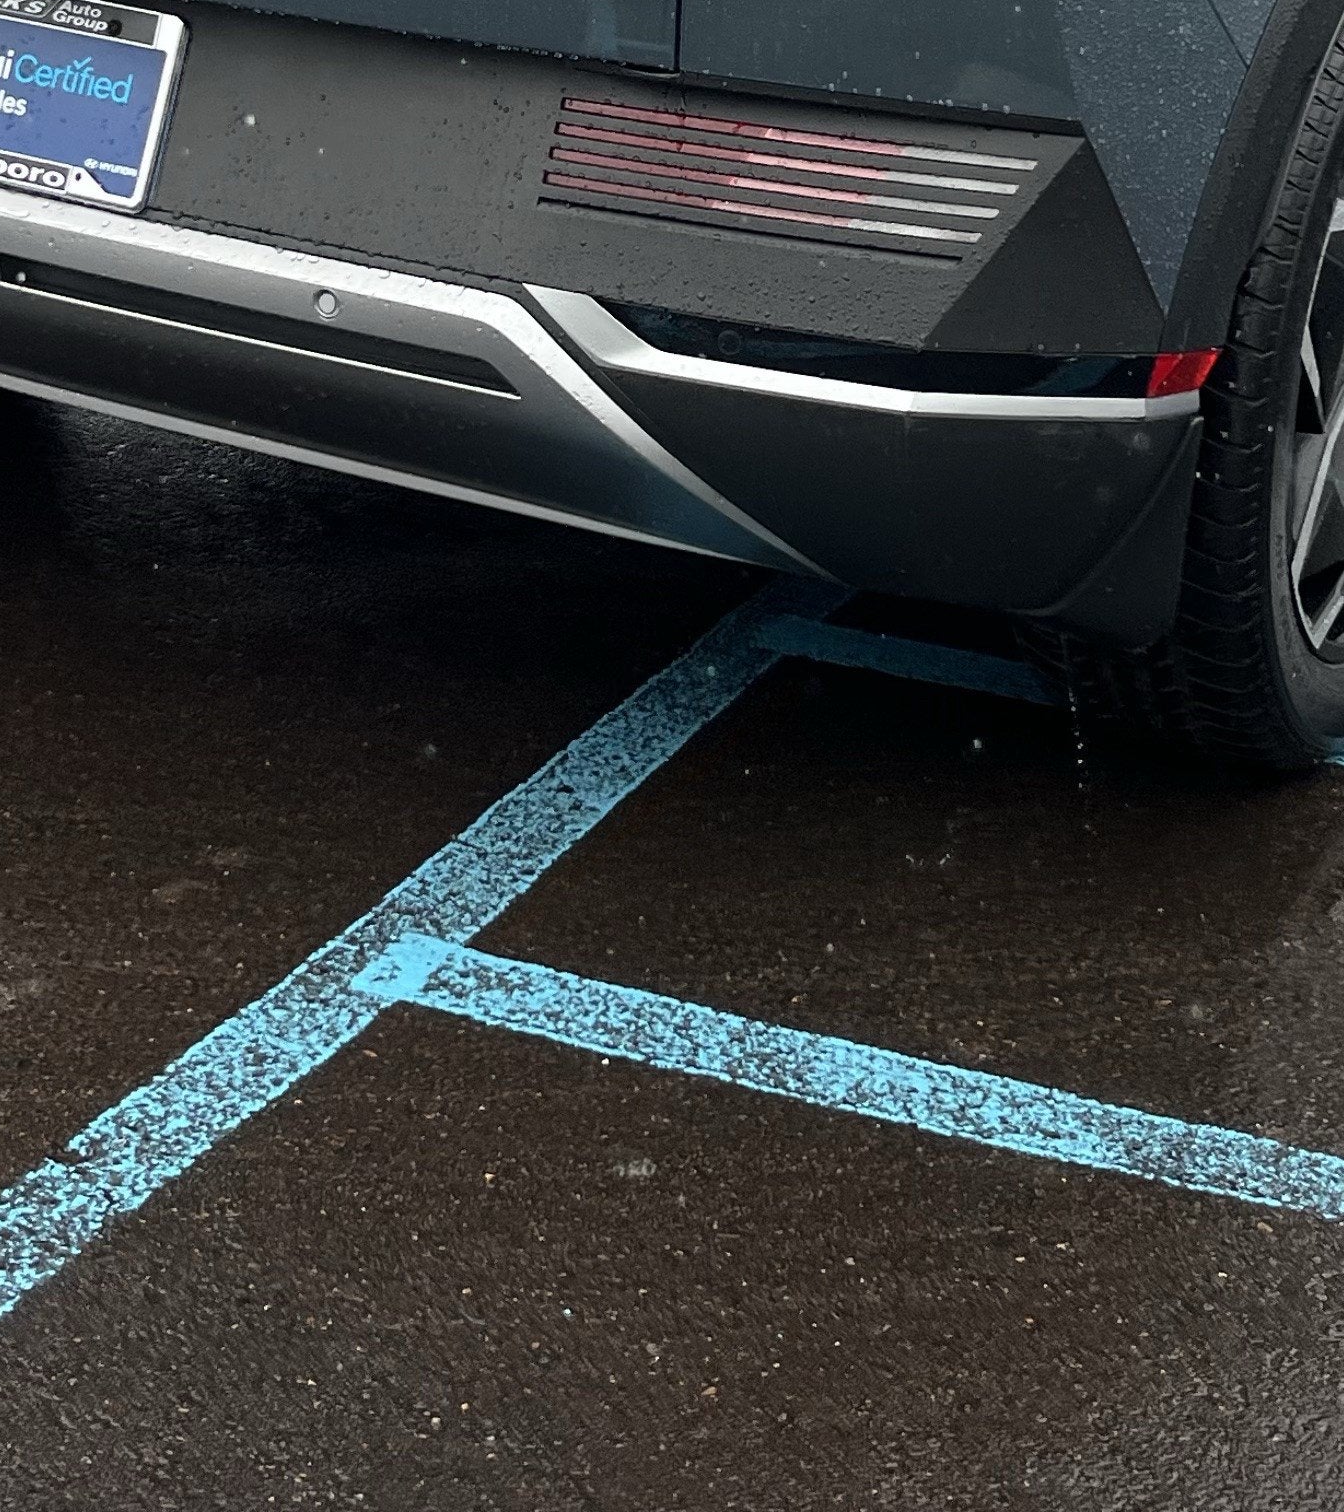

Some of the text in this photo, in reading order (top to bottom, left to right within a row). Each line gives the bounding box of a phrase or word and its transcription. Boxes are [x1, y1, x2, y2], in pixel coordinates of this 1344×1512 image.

[58, 0, 103, 18] Auto
[52, 10, 109, 33] Group
[13, 53, 134, 104] Certified
